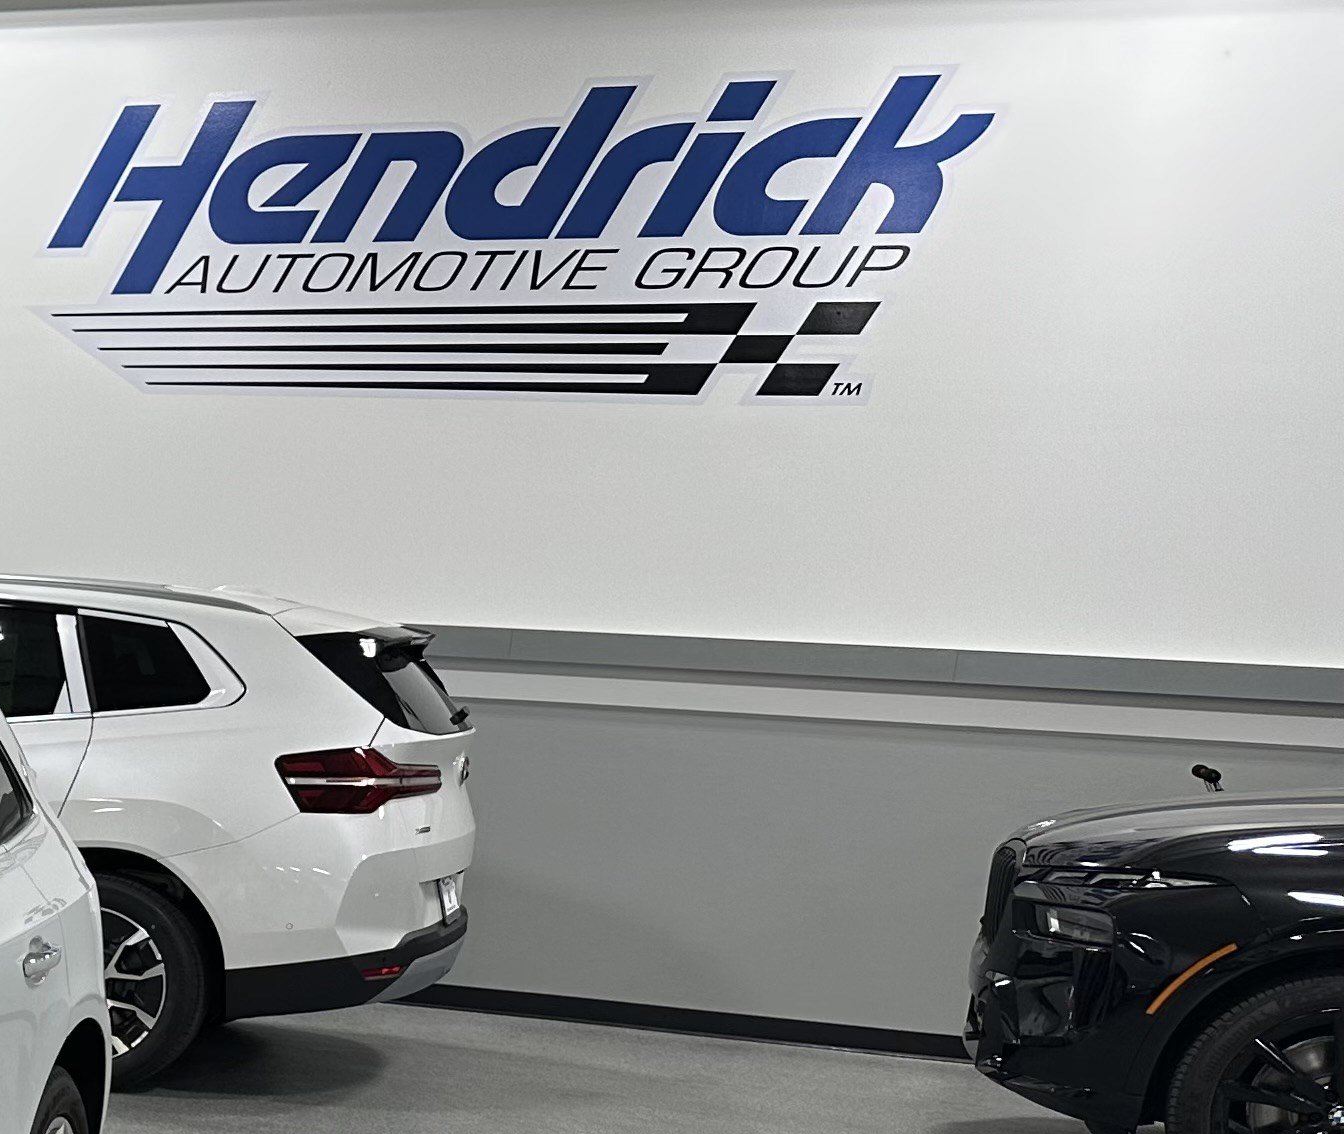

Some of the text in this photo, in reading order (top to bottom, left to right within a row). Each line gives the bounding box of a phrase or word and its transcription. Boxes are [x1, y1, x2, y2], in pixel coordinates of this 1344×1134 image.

[47, 74, 996, 295] Hendrick
[163, 244, 912, 295] AUTOMOTIVE GROUP
[831, 382, 863, 396] TM
